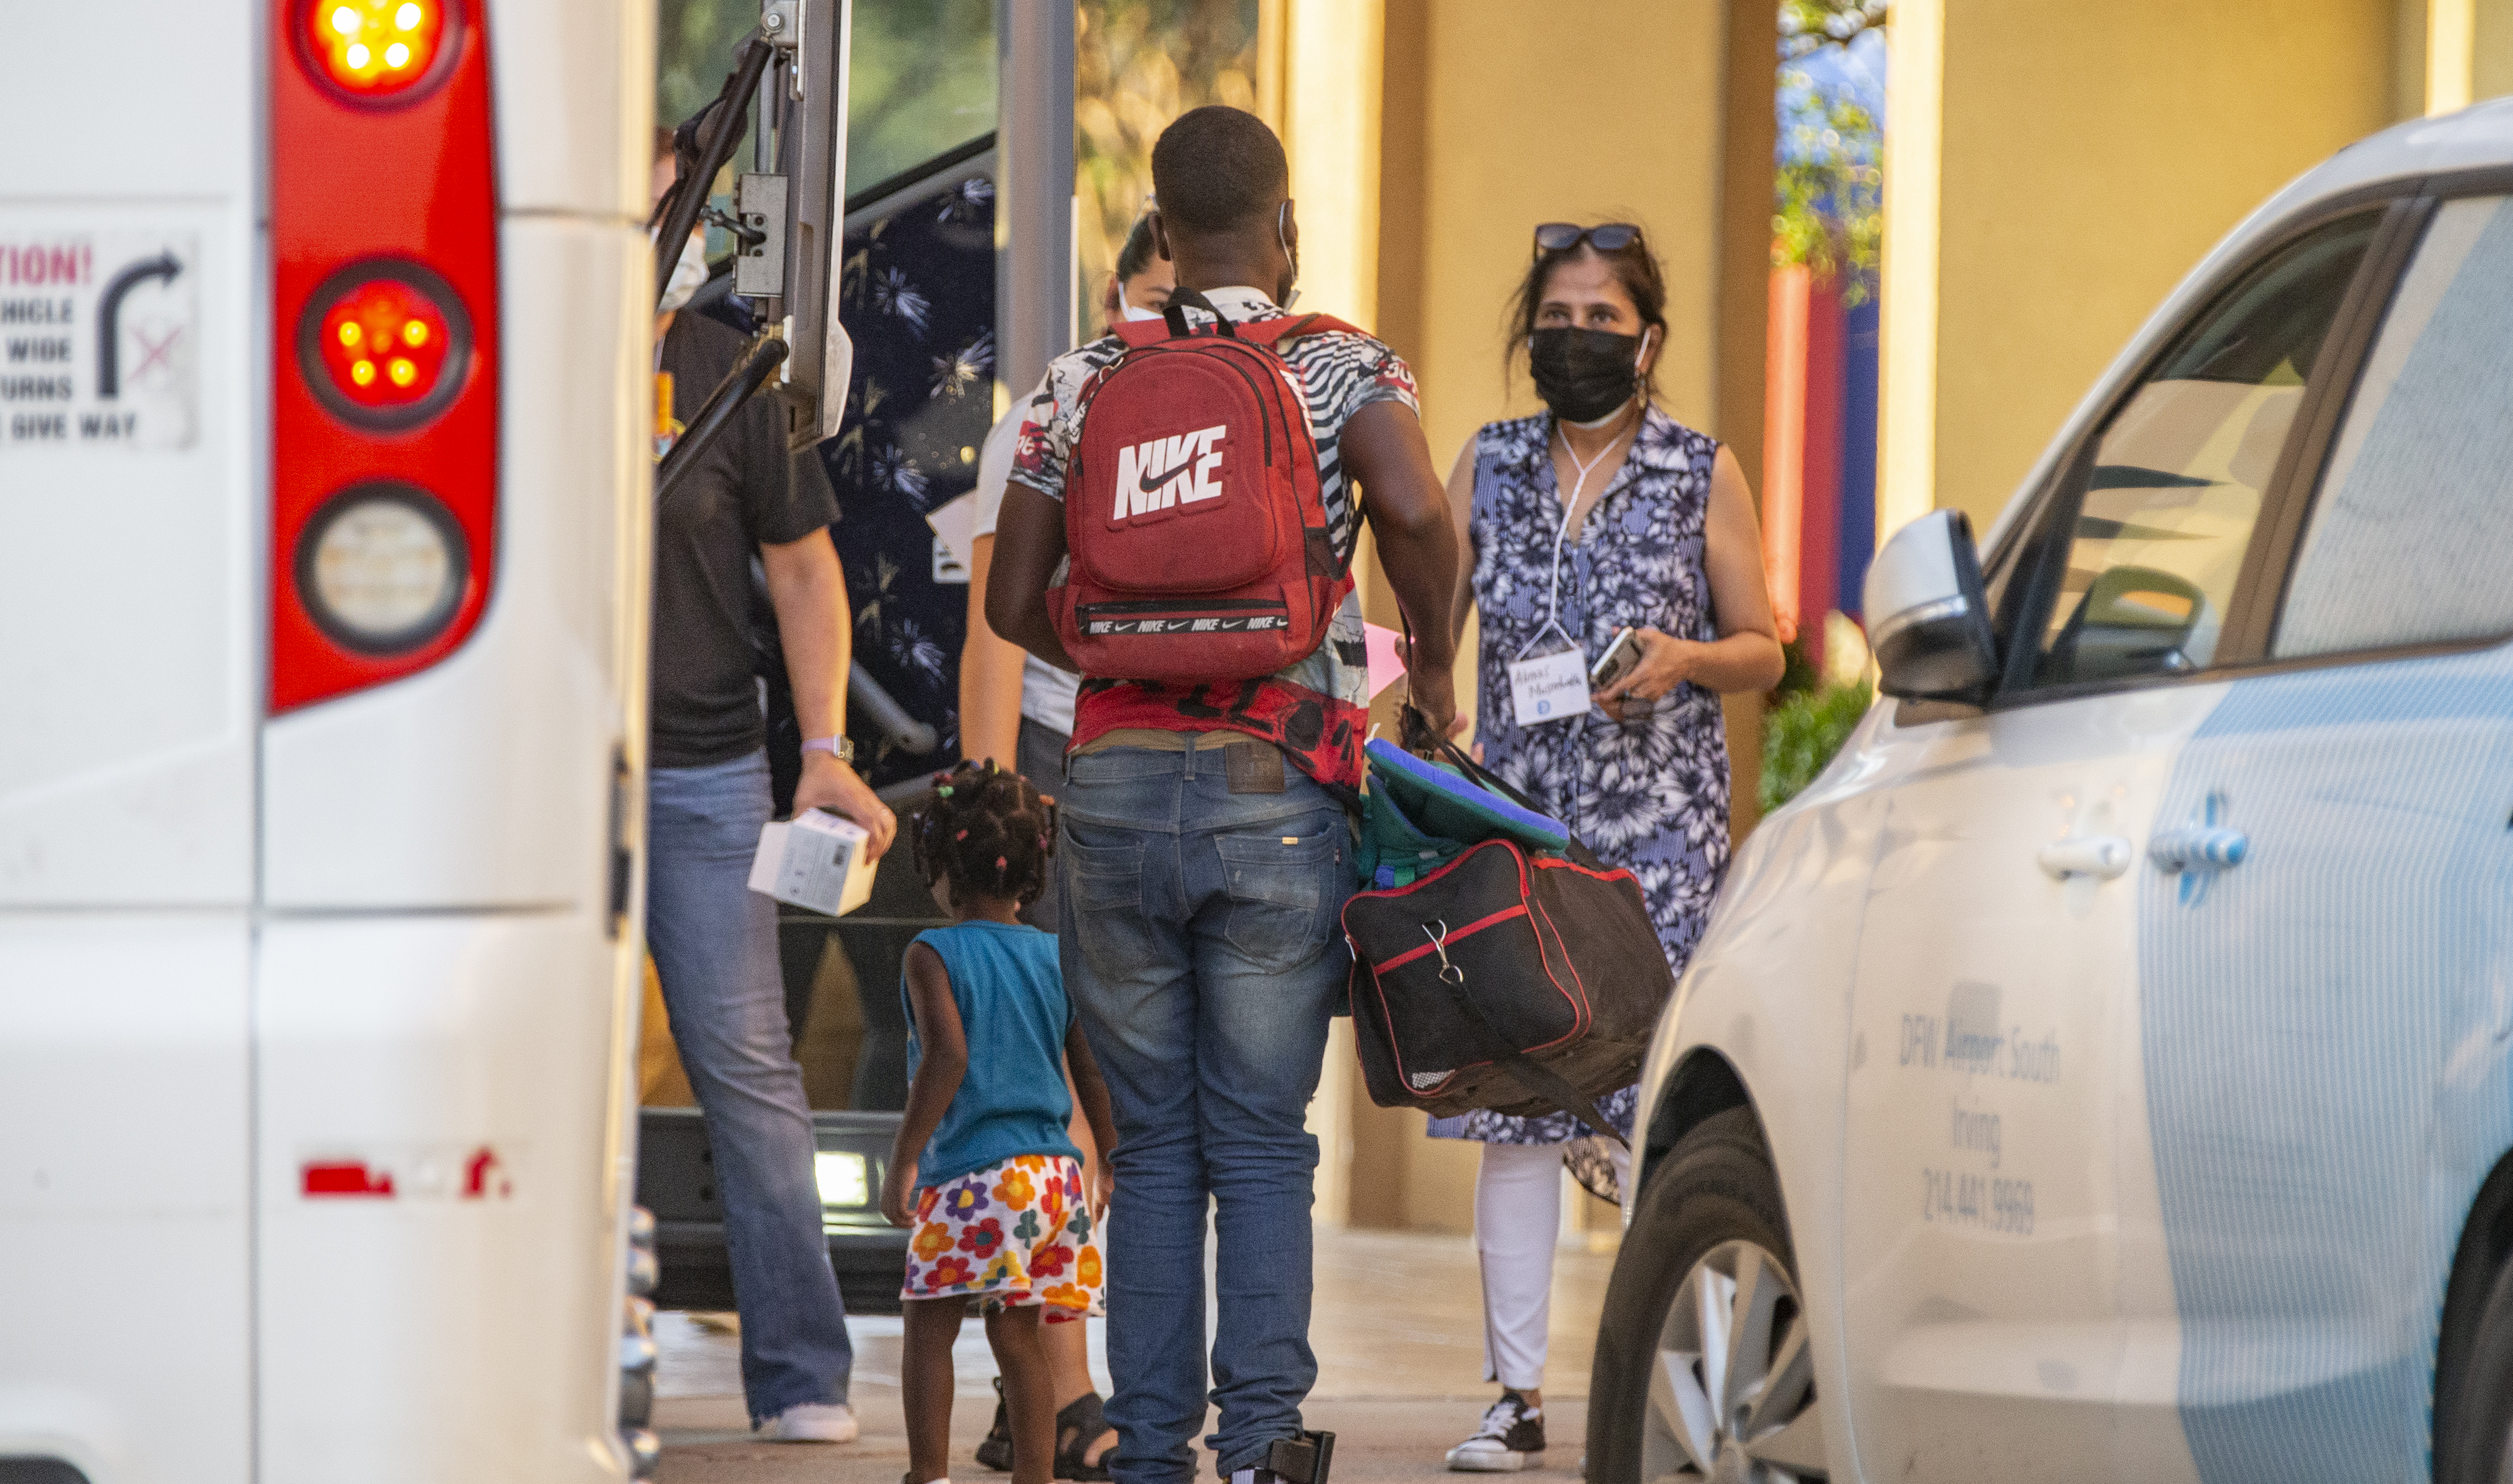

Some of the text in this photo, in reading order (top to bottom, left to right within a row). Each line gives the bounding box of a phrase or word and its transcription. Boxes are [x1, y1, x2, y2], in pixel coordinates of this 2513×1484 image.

[6, 336, 72, 362] WIDE
[11, 413, 67, 439] GIVE
[77, 413, 136, 439] WAY
[1113, 425, 1227, 520] NIKE
[1137, 620, 1165, 633] NIKE
[1191, 618, 1220, 631] NIKE
[1247, 617, 1275, 629] NIKE
[1899, 1013, 2061, 1087] DFW Airport South
[1952, 1095, 2002, 1170] Irving
